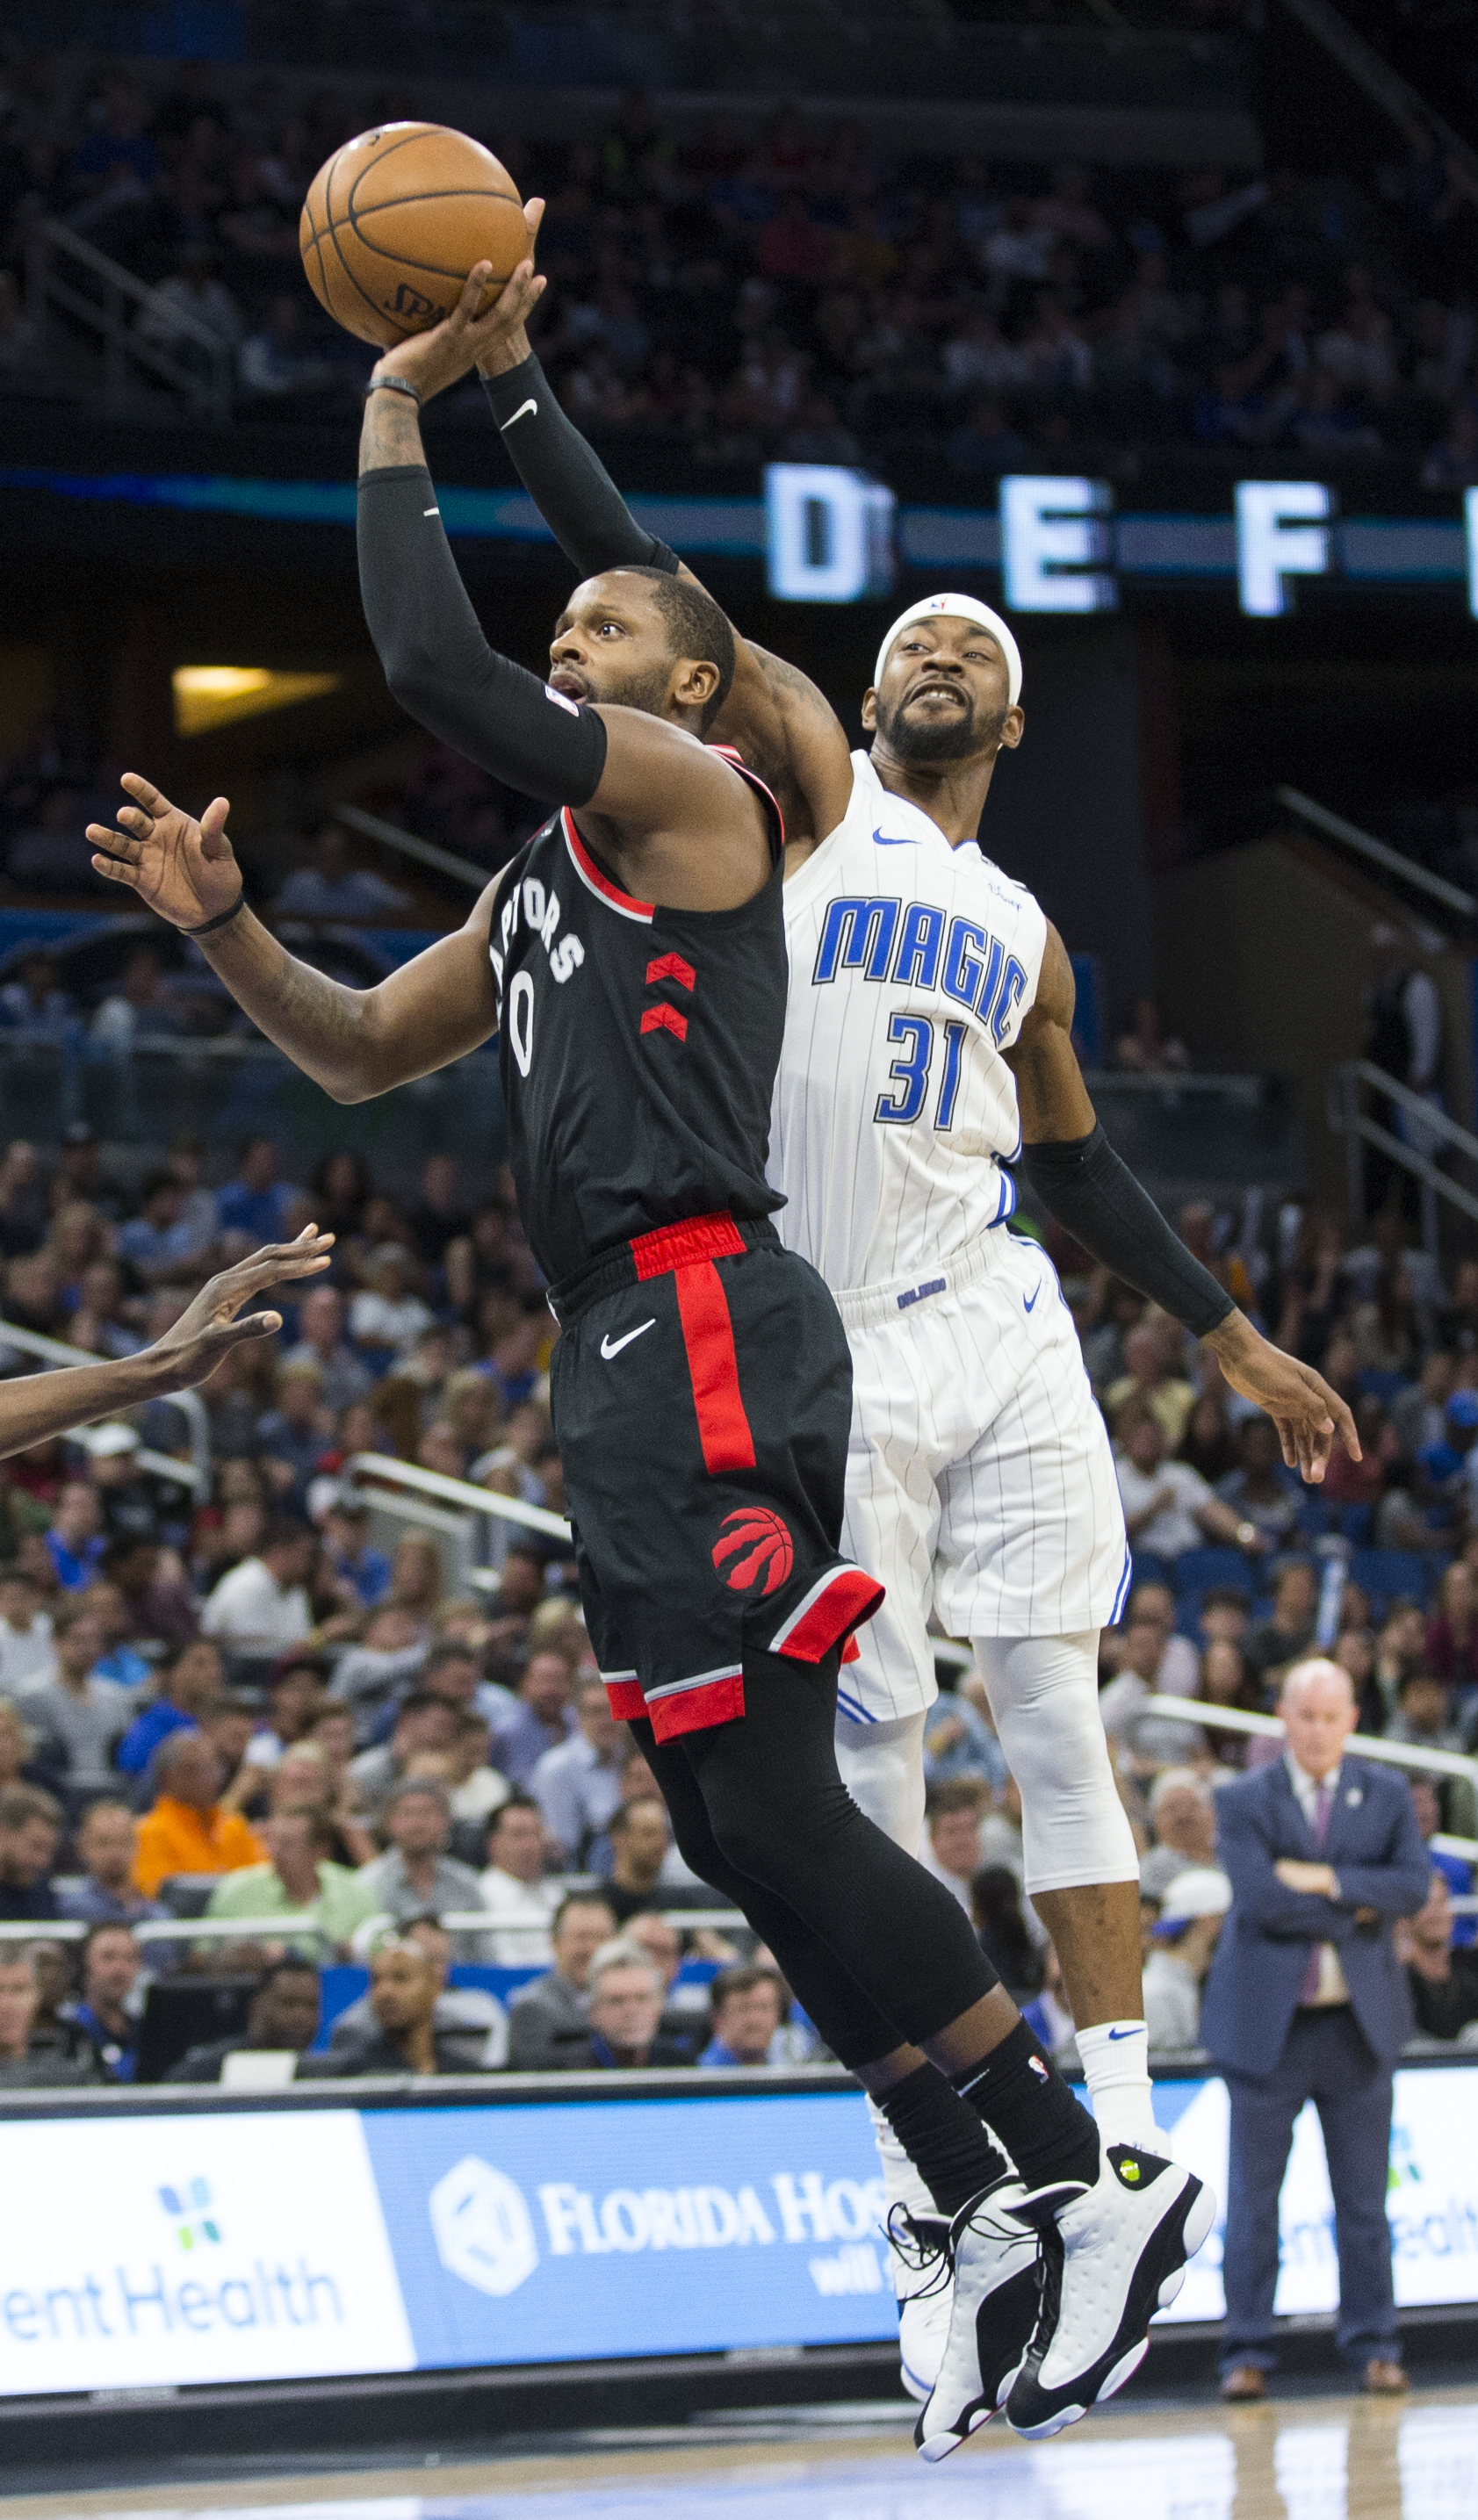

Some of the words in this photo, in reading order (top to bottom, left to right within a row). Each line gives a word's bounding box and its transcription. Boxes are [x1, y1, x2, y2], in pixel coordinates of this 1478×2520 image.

[489, 876, 585, 1031] APTORS
[811, 896, 1028, 1050] MAGIC
[509, 970, 535, 1077] 0
[873, 1012, 970, 1132] 31
[534, 2180, 775, 2256] FLORIDA
[807, 2244, 883, 2297] will
[1, 2254, 346, 2342] entHealth
